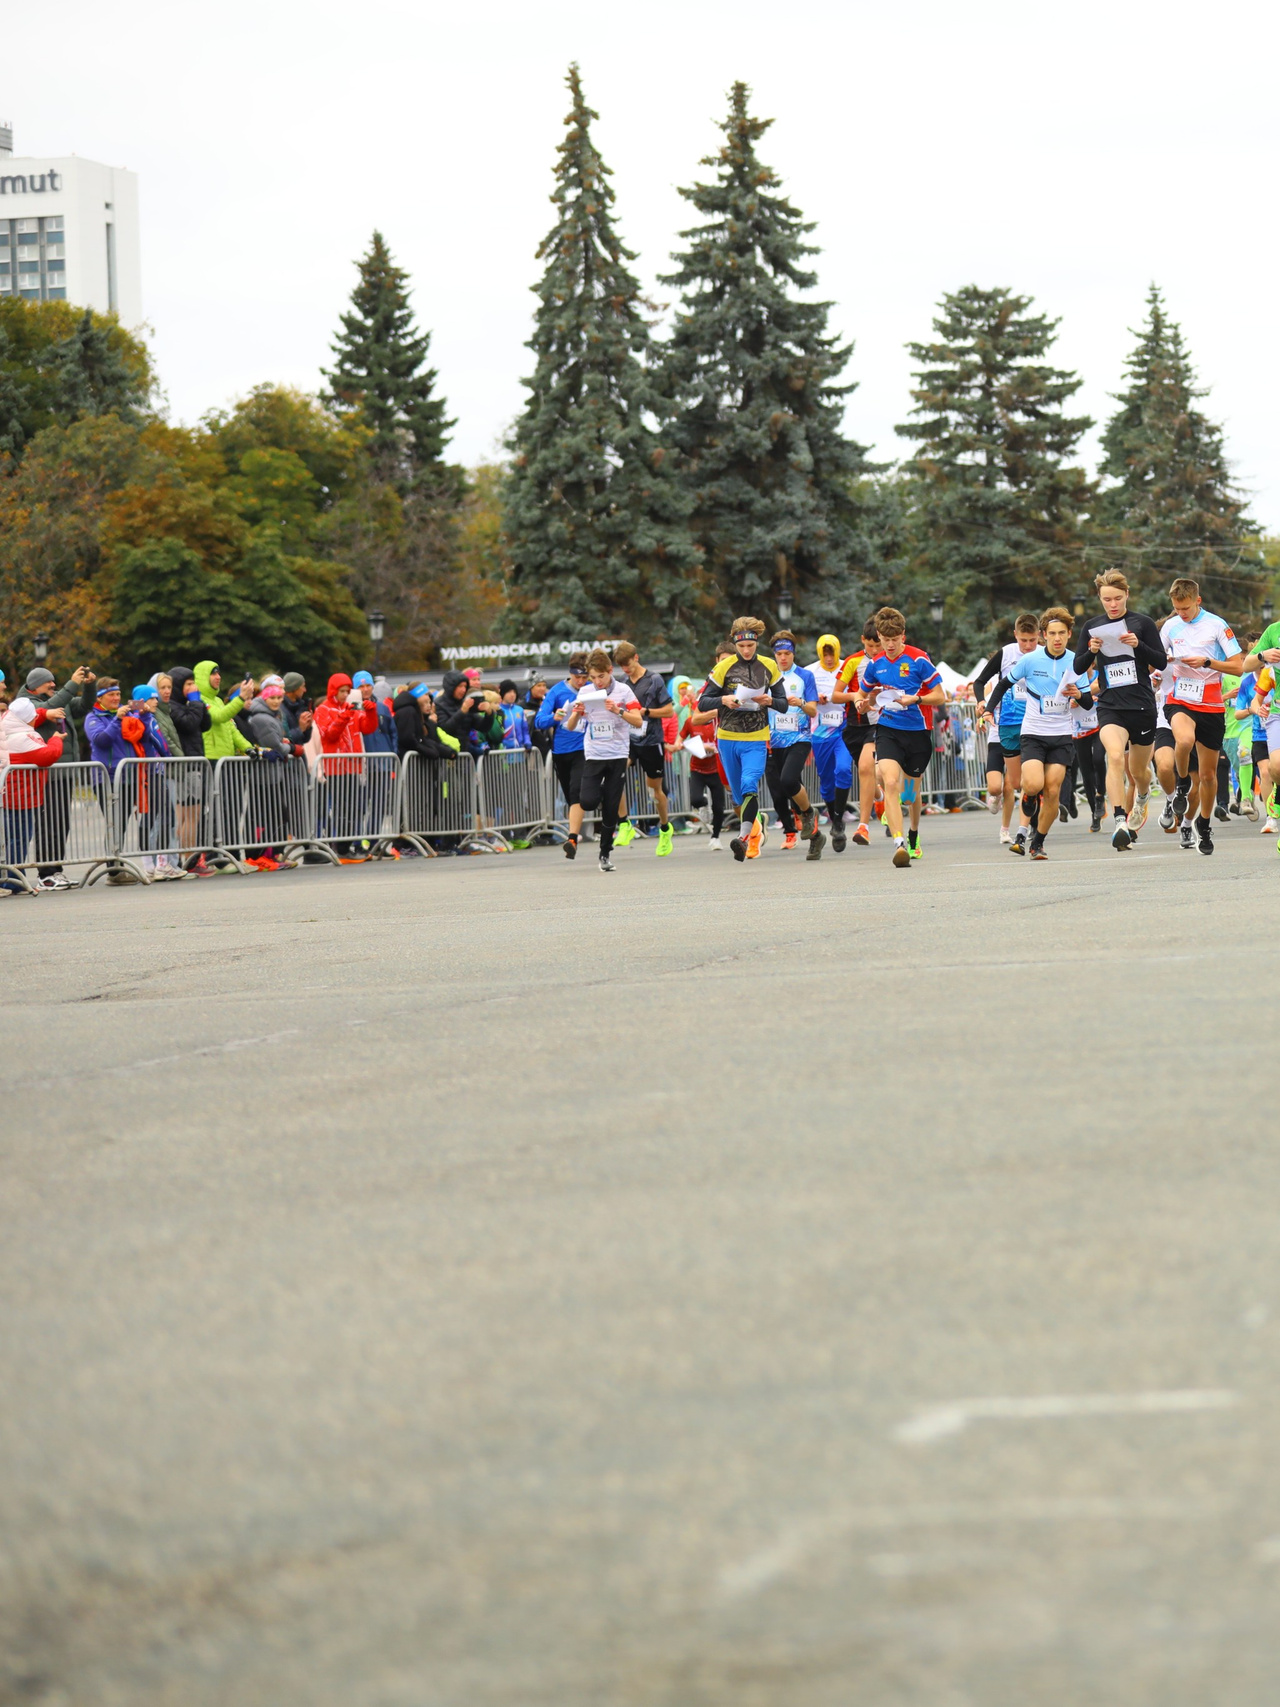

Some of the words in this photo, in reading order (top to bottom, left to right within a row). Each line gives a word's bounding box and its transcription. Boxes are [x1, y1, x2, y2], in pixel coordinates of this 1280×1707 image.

[440, 642, 550, 661] УЛЬЯНОВСКАЯ
[559, 639, 624, 656] ОБЛАСТ
[1109, 666, 1132, 679] 308.1
[1177, 682, 1200, 694] 327.1
[776, 716, 795, 725] 305.1
[593, 724, 612, 733] 342.1
